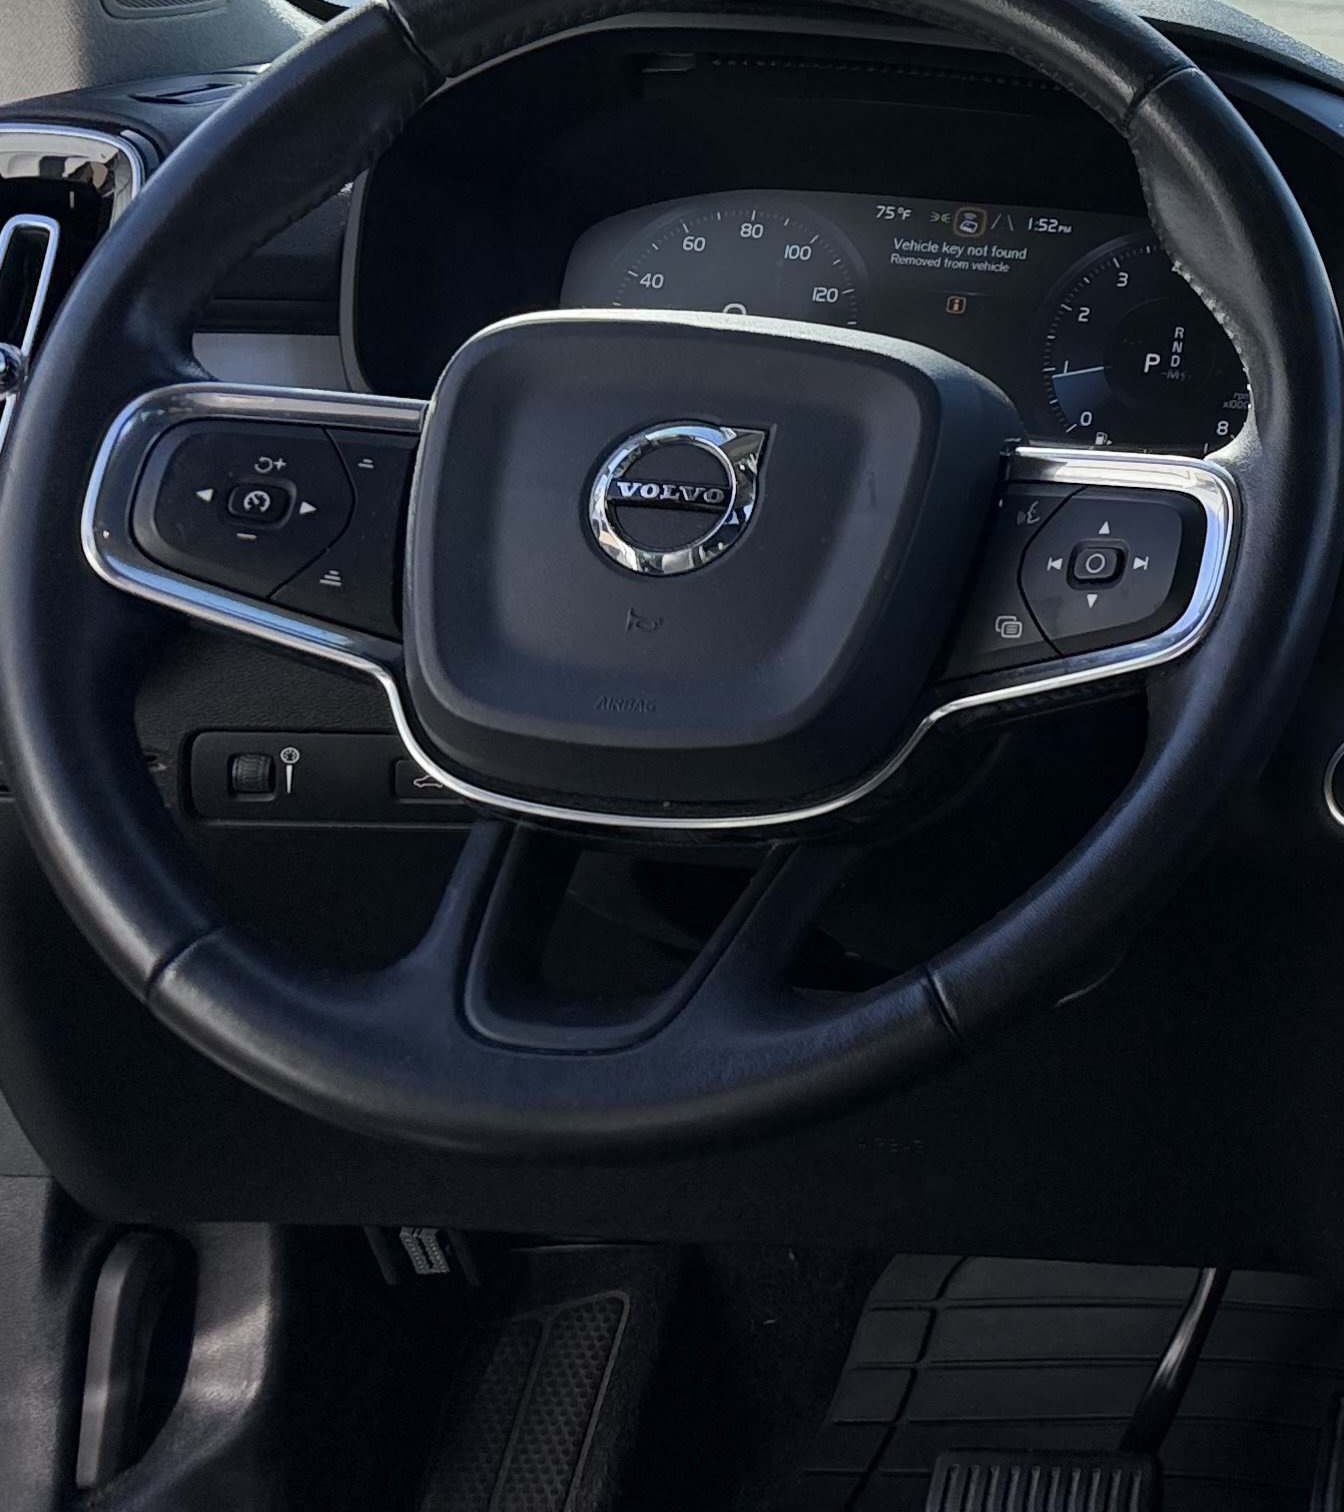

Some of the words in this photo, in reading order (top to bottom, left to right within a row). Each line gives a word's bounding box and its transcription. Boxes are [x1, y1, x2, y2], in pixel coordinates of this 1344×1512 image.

[875, 205, 913, 221] 75°F
[740, 222, 764, 240] 80
[682, 236, 707, 253] 60
[784, 244, 813, 261] 100
[893, 238, 940, 254] Vehicle
[942, 242, 965, 258] key
[967, 245, 989, 257] not
[991, 245, 1028, 261] found
[890, 253, 941, 268] Removed
[943, 258, 970, 271] from
[971, 261, 1011, 273] vehicle
[639, 273, 664, 289] 40
[1115, 271, 1129, 288] 3
[811, 287, 839, 304] 120
[1077, 306, 1091, 323] 2
[1174, 326, 1185, 339] R
[1172, 341, 1184, 353] N
[1143, 353, 1161, 373] P
[1170, 354, 1181, 368] D
[1079, 410, 1093, 427] 0
[1215, 420, 1230, 436] 8
[617, 481, 725, 505] VOLVO
